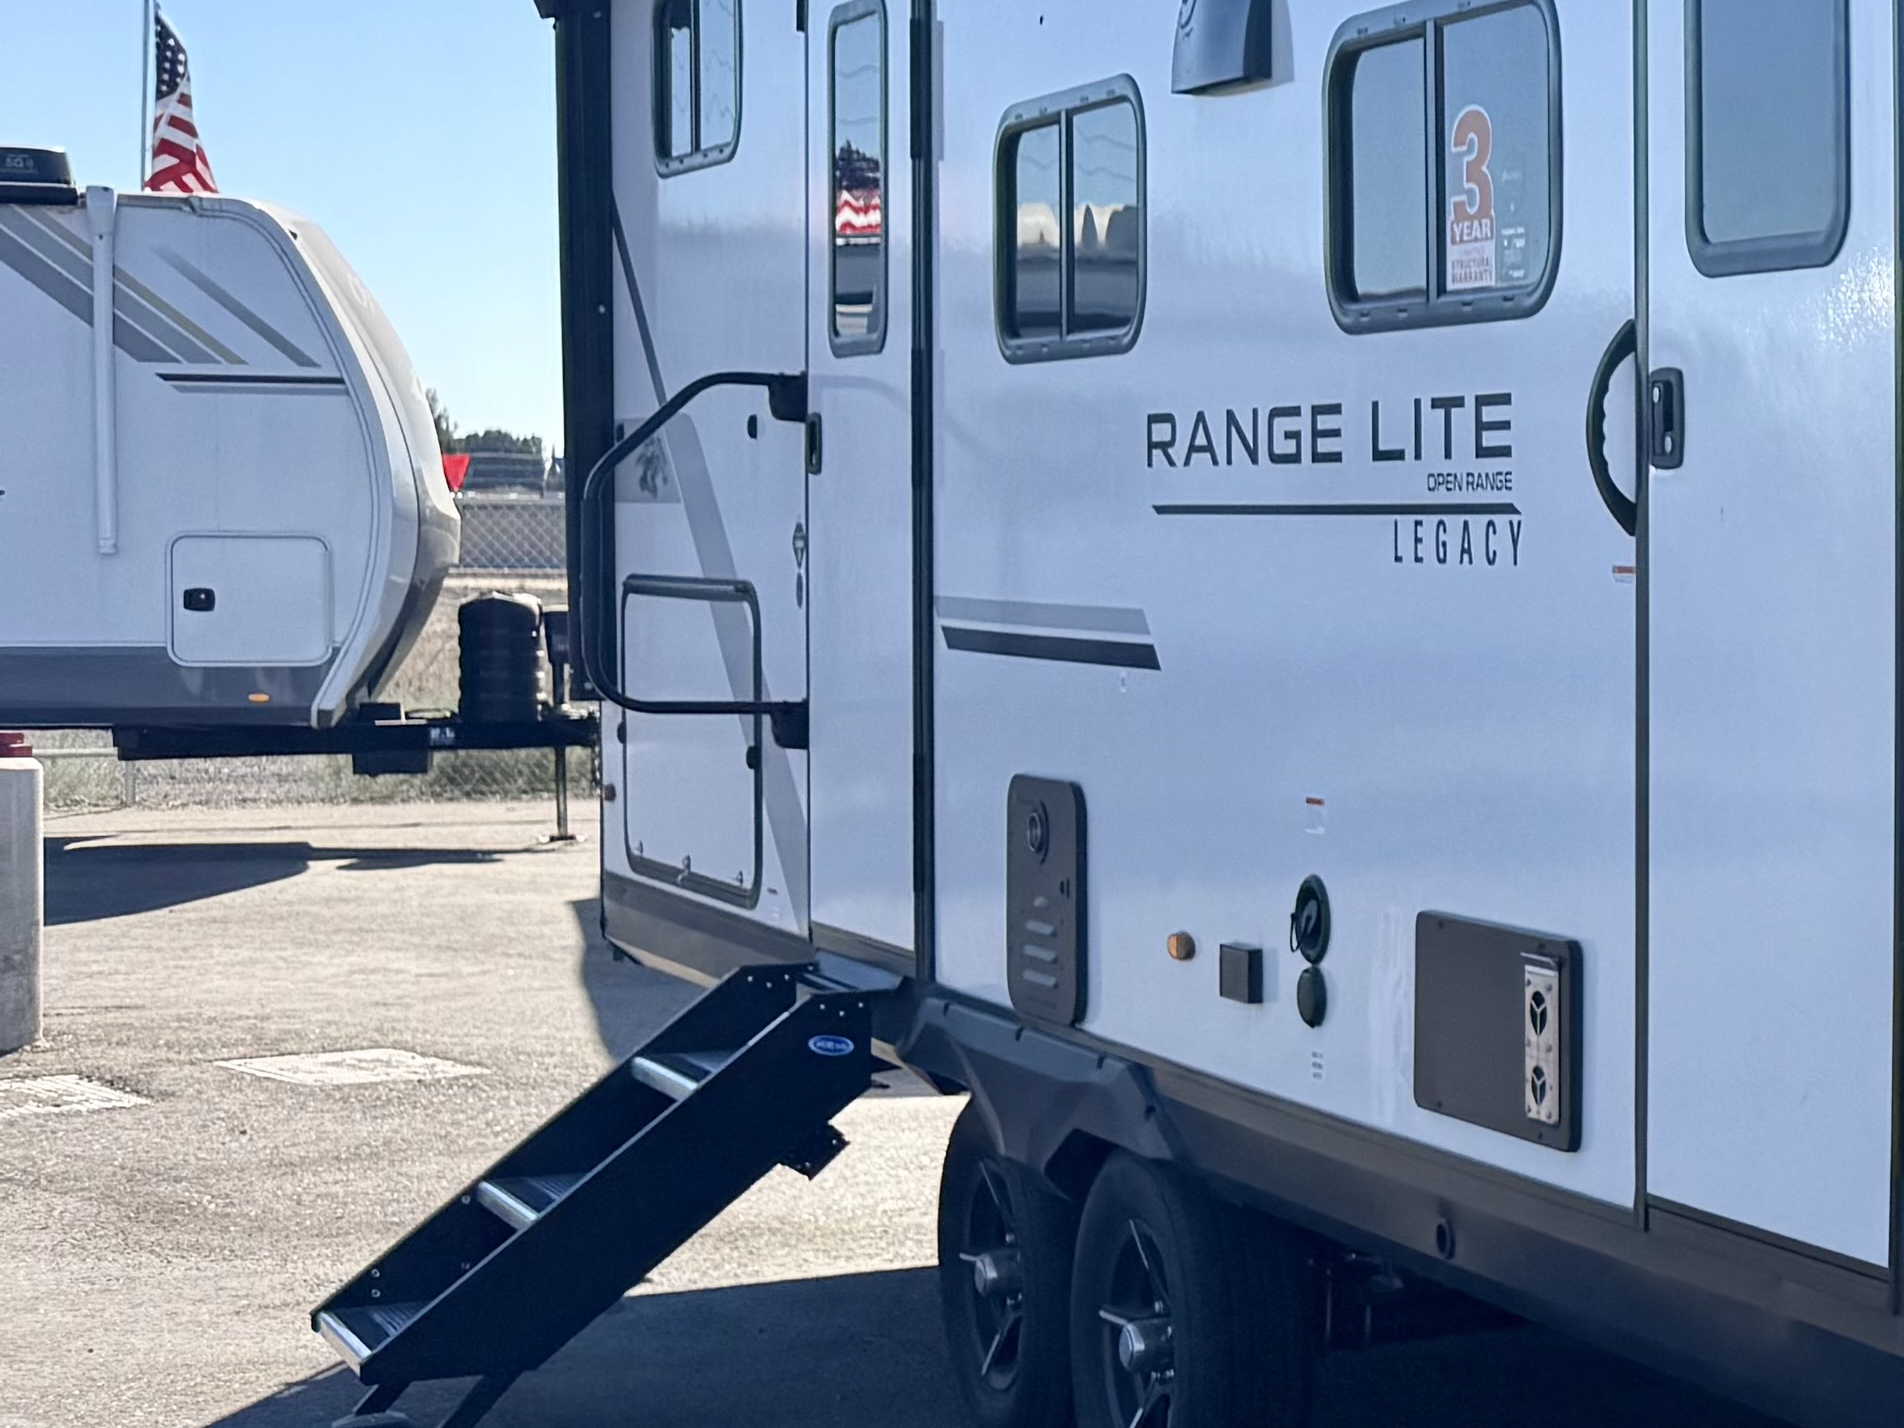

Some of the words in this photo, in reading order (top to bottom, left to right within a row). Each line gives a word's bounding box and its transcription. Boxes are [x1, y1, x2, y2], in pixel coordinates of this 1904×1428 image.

[1451, 104, 1494, 222] 3
[1452, 218, 1492, 243] YEAR
[1146, 403, 1343, 468] RANGE
[1371, 392, 1513, 462] LITE
[1426, 472, 1464, 493] OPEN
[1465, 470, 1513, 492] RANGE
[1393, 518, 1522, 567] LEGACY
